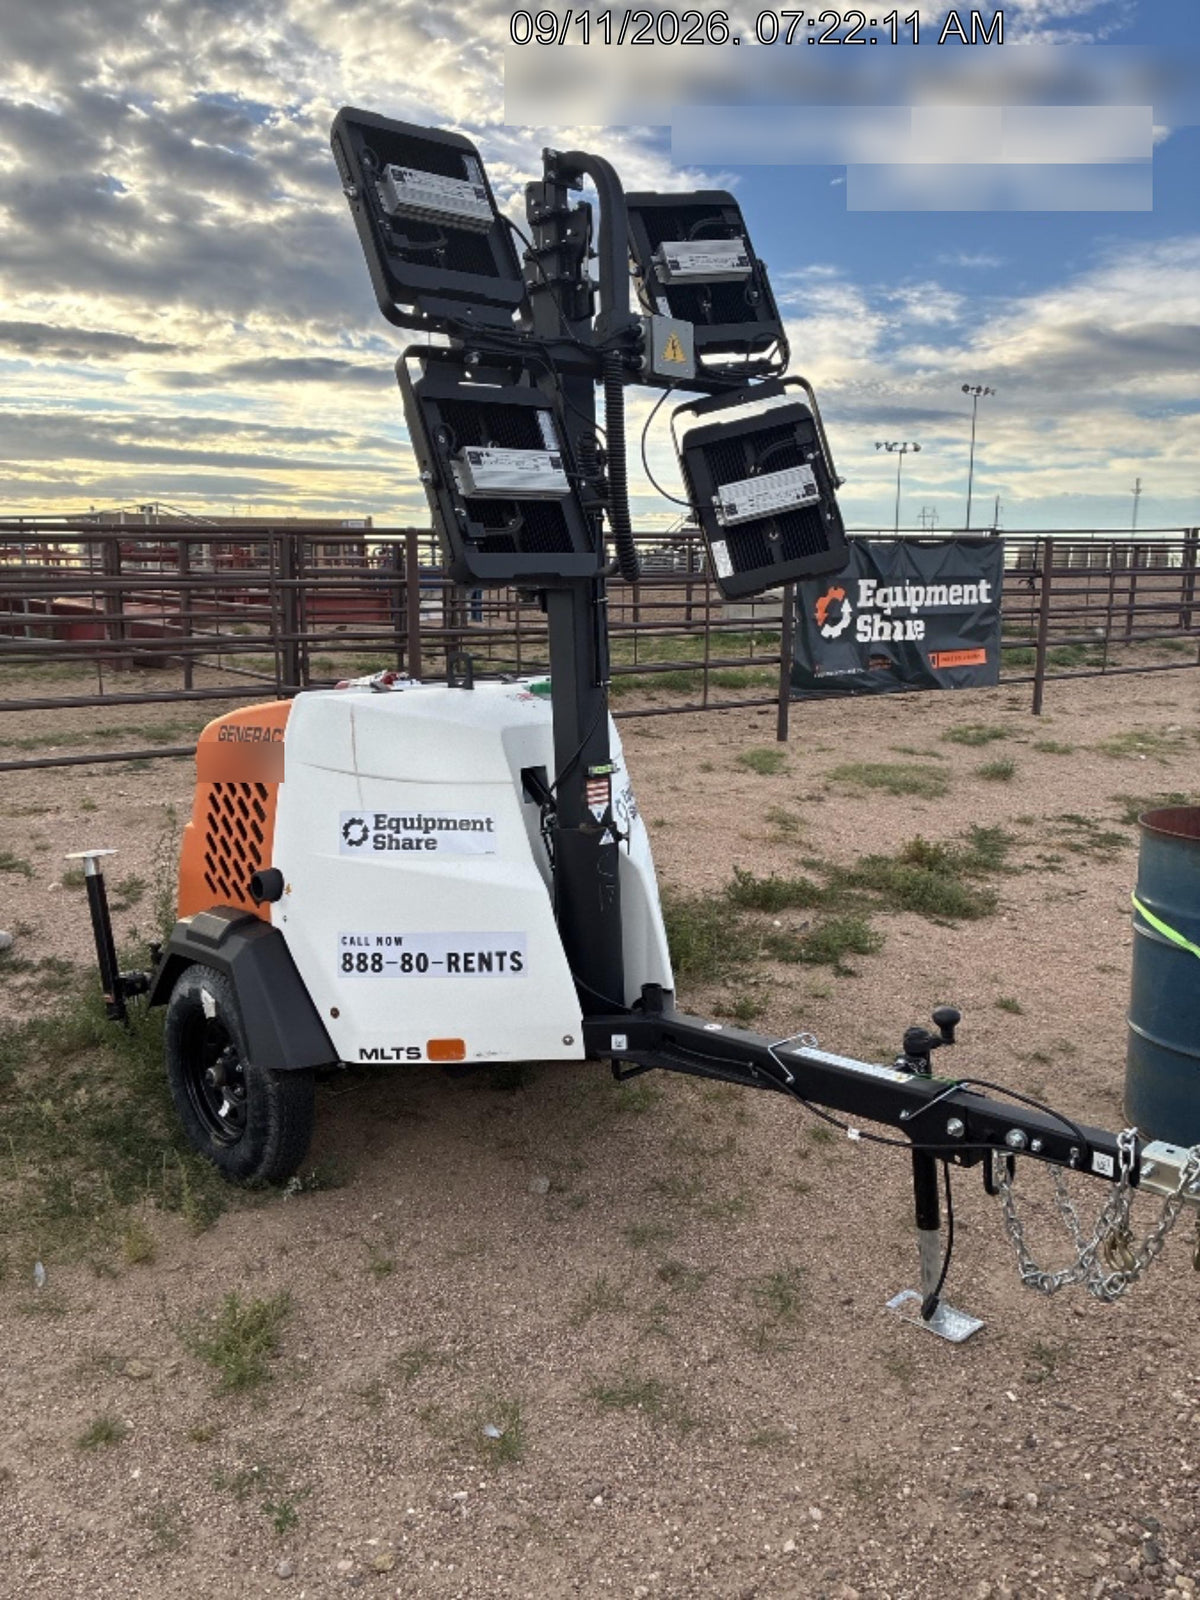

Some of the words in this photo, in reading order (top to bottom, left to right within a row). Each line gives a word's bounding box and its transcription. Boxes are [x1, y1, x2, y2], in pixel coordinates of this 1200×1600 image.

[857, 579, 992, 615] Equipment
[218, 725, 284, 742] GENERAC
[373, 814, 494, 834] Equipment
[373, 834, 438, 850] Share
[341, 936, 370, 946] CALL
[376, 936, 403, 946] NOW
[341, 951, 523, 973] 888-80-RENTS
[359, 1047, 422, 1060] MLTS
